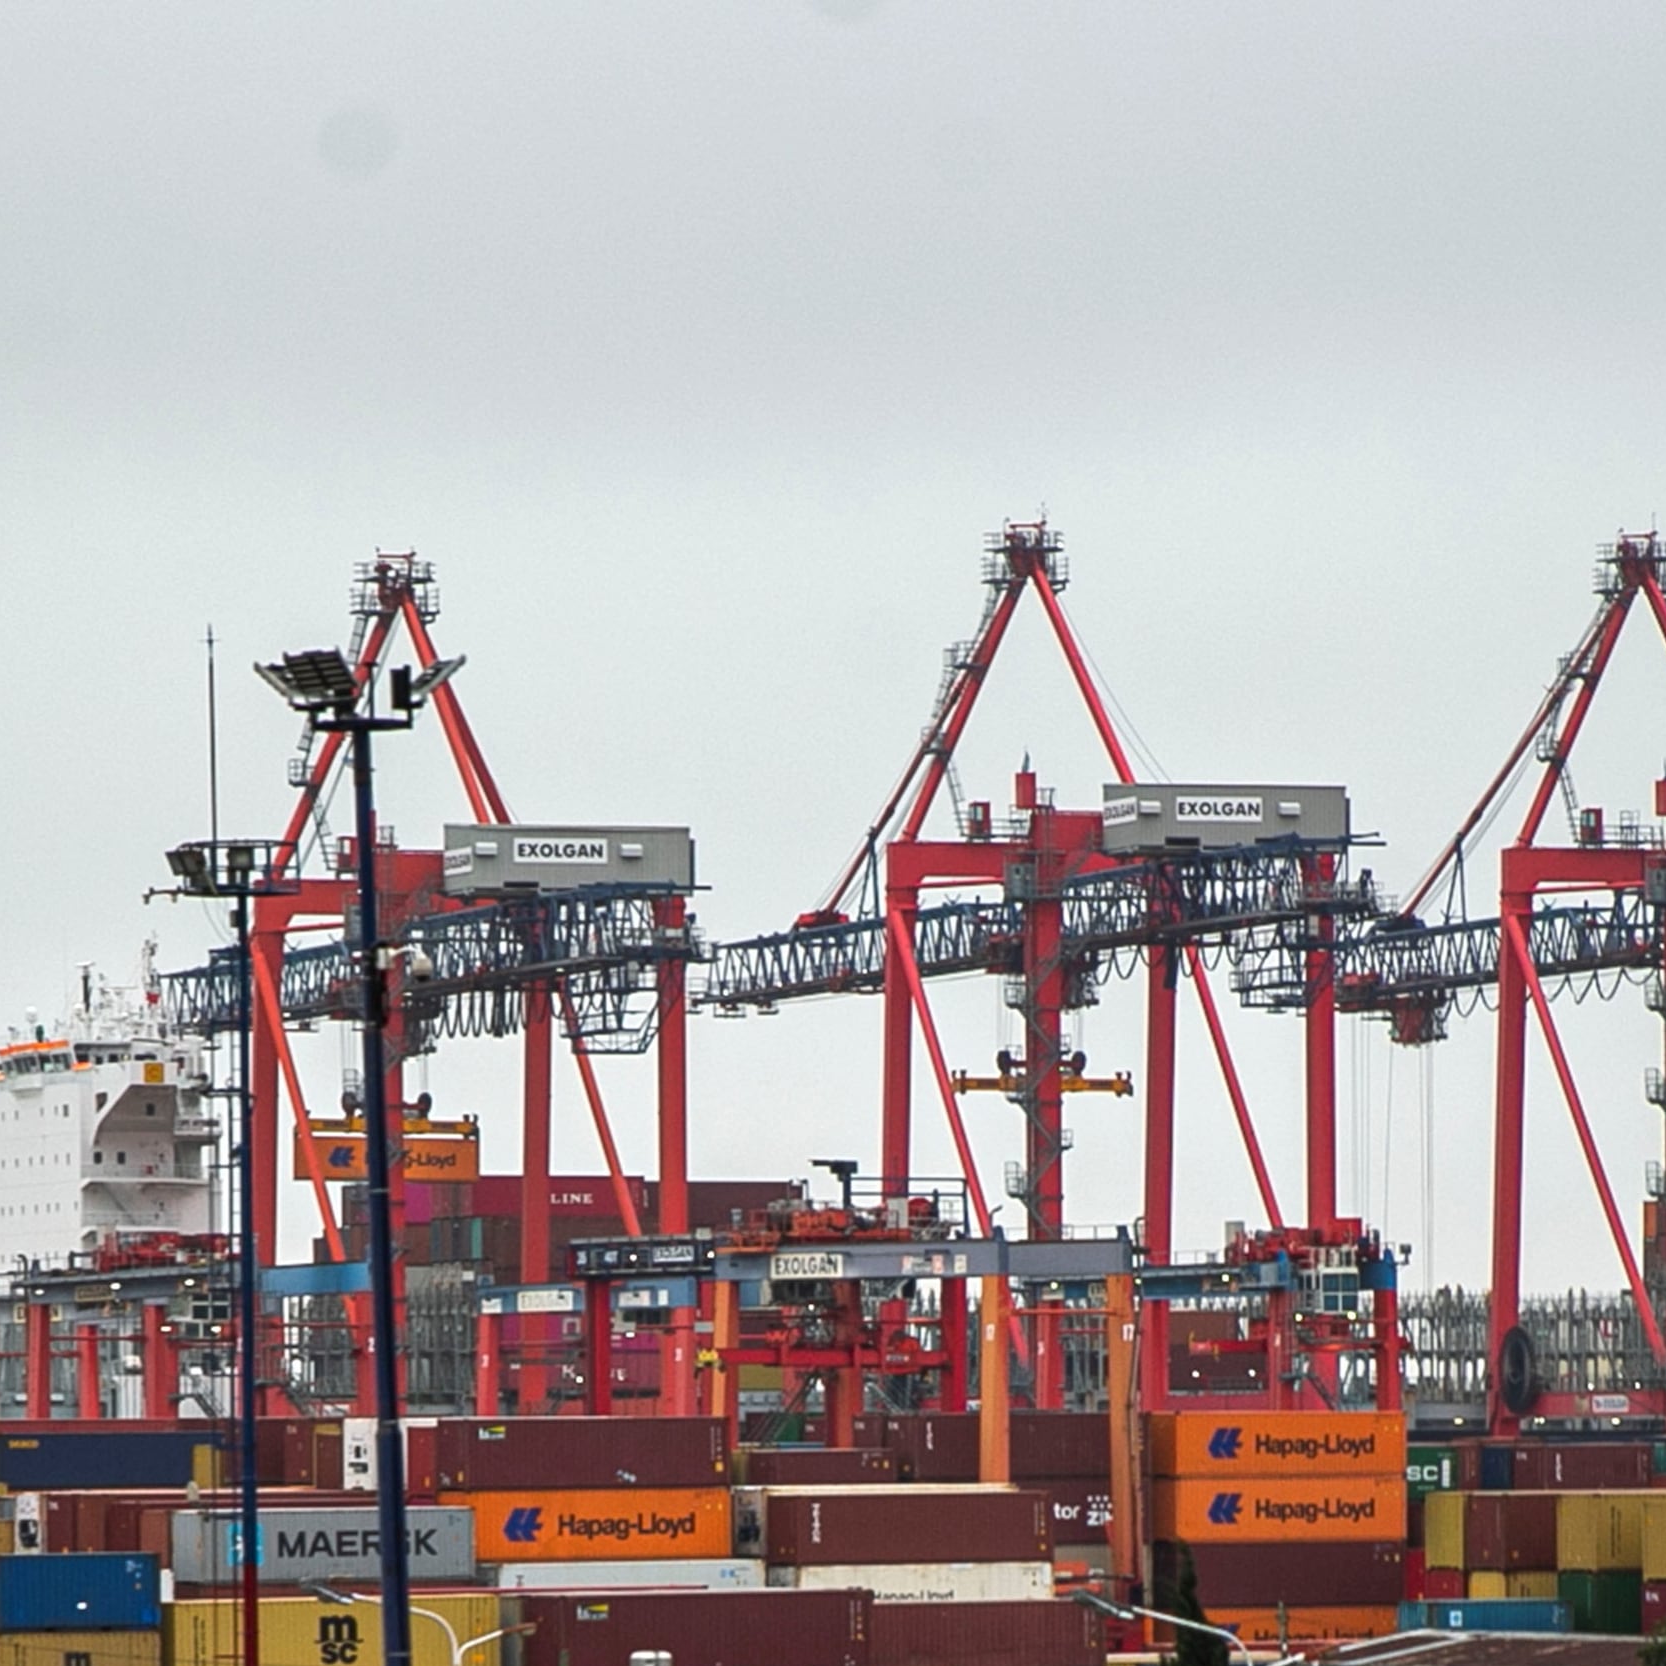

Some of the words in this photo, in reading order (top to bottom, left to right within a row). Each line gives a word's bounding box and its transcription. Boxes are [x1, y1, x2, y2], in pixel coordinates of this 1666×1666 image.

[1177, 803, 1260, 816] EXOLGAN
[517, 844, 604, 858] EXOLGAN
[551, 1192, 593, 1204] LINE
[774, 1257, 840, 1275] EXOLGAN
[1255, 1434, 1375, 1458] Hapag-Lloyd
[1255, 1499, 1375, 1523] Hapag-Lloyd
[557, 1511, 695, 1541] Hapag-Lloyd
[278, 1529, 438, 1558] MAERK
